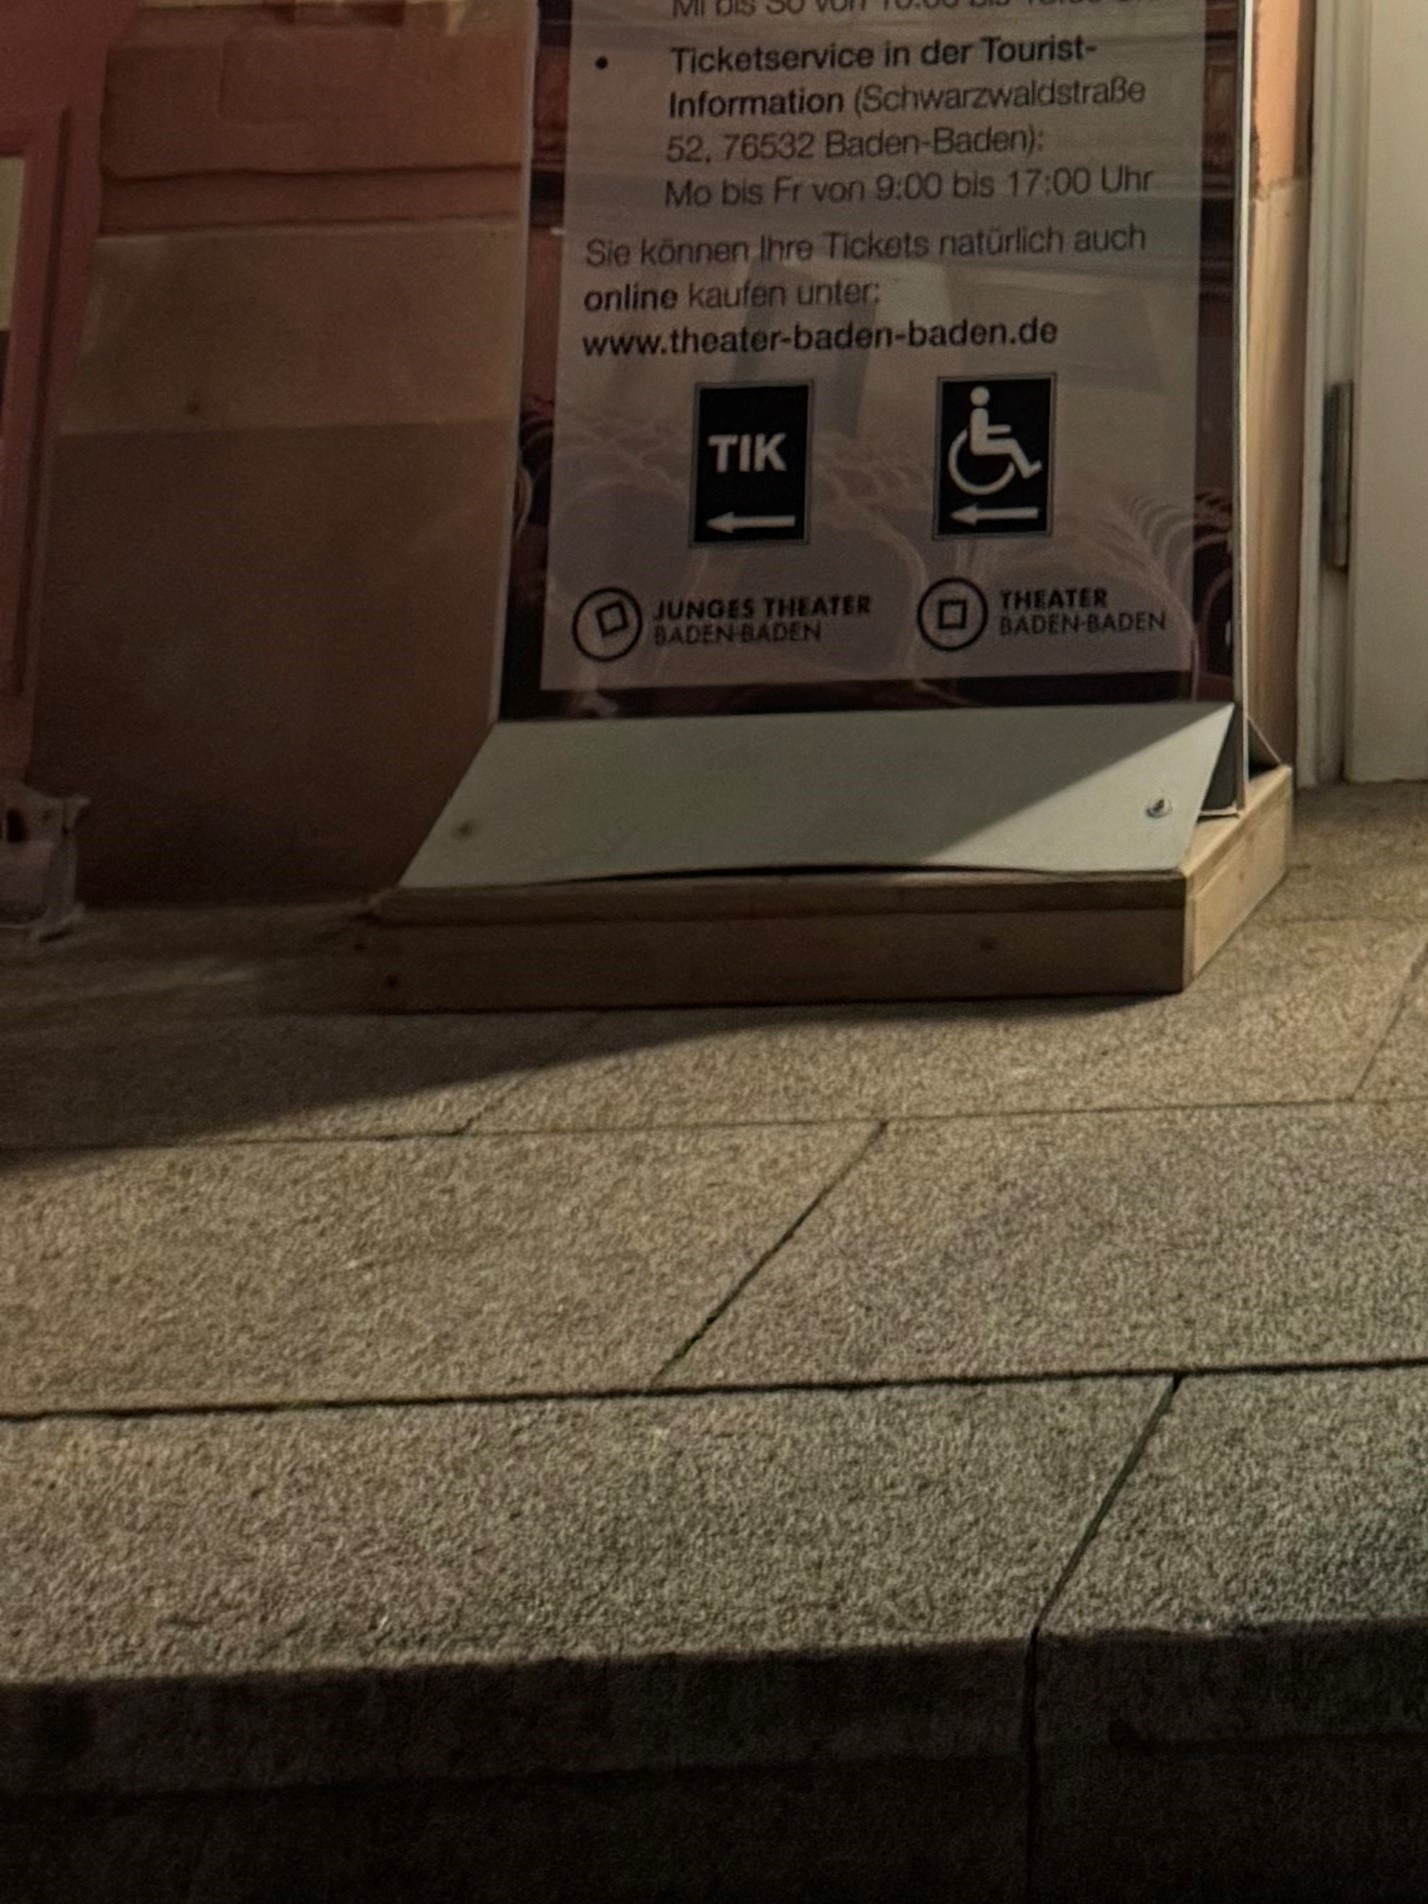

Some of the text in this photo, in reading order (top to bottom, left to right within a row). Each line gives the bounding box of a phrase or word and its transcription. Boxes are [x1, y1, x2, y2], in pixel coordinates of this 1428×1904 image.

[671, 34, 1097, 74] Ticketservice in der Tourist-
[668, 76, 1146, 118] Information (Schwarzwaldstraße
[666, 125, 1044, 167] 52, 76532 Baden-Baden):
[665, 164, 1154, 207] Mo bis Fr von 9:00 bis 17:00 Uhr
[586, 223, 1147, 268] Sie können Ihre Tickets natürlich auch
[584, 280, 880, 312] online kaufen unter:
[583, 318, 1058, 357] www.theater-baden-baden.de
[708, 432, 787, 474] TIK
[653, 595, 872, 621] JUNGES THEATER
[1000, 587, 1109, 609] THEATER
[653, 622, 822, 645] BADEN-BADEN
[1000, 612, 1167, 635] BADEN-BADEN
